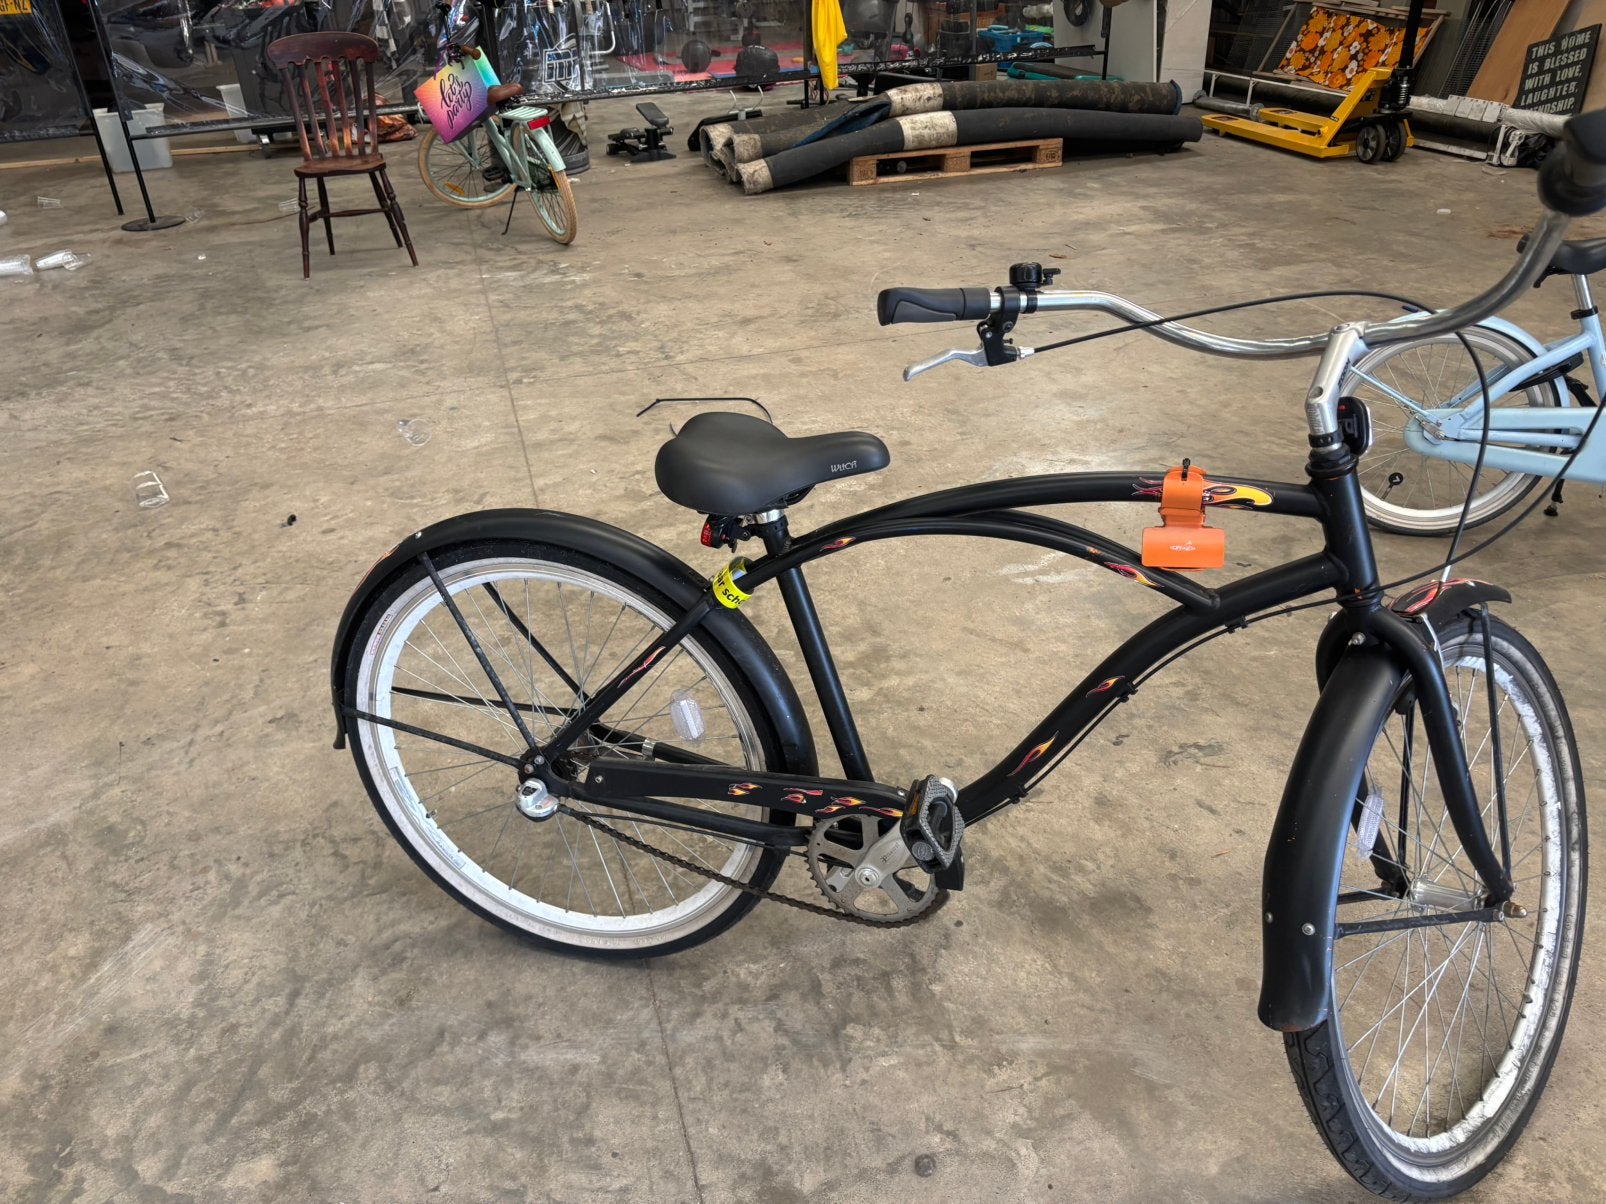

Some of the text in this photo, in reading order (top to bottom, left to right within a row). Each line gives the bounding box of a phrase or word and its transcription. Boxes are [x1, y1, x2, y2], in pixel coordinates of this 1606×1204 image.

[1527, 48, 1588, 75] IS BLESSED
[1532, 42, 1556, 59] THIS
[1524, 65, 1582, 91] WITH LOVE,
[446, 81, 472, 129] party
